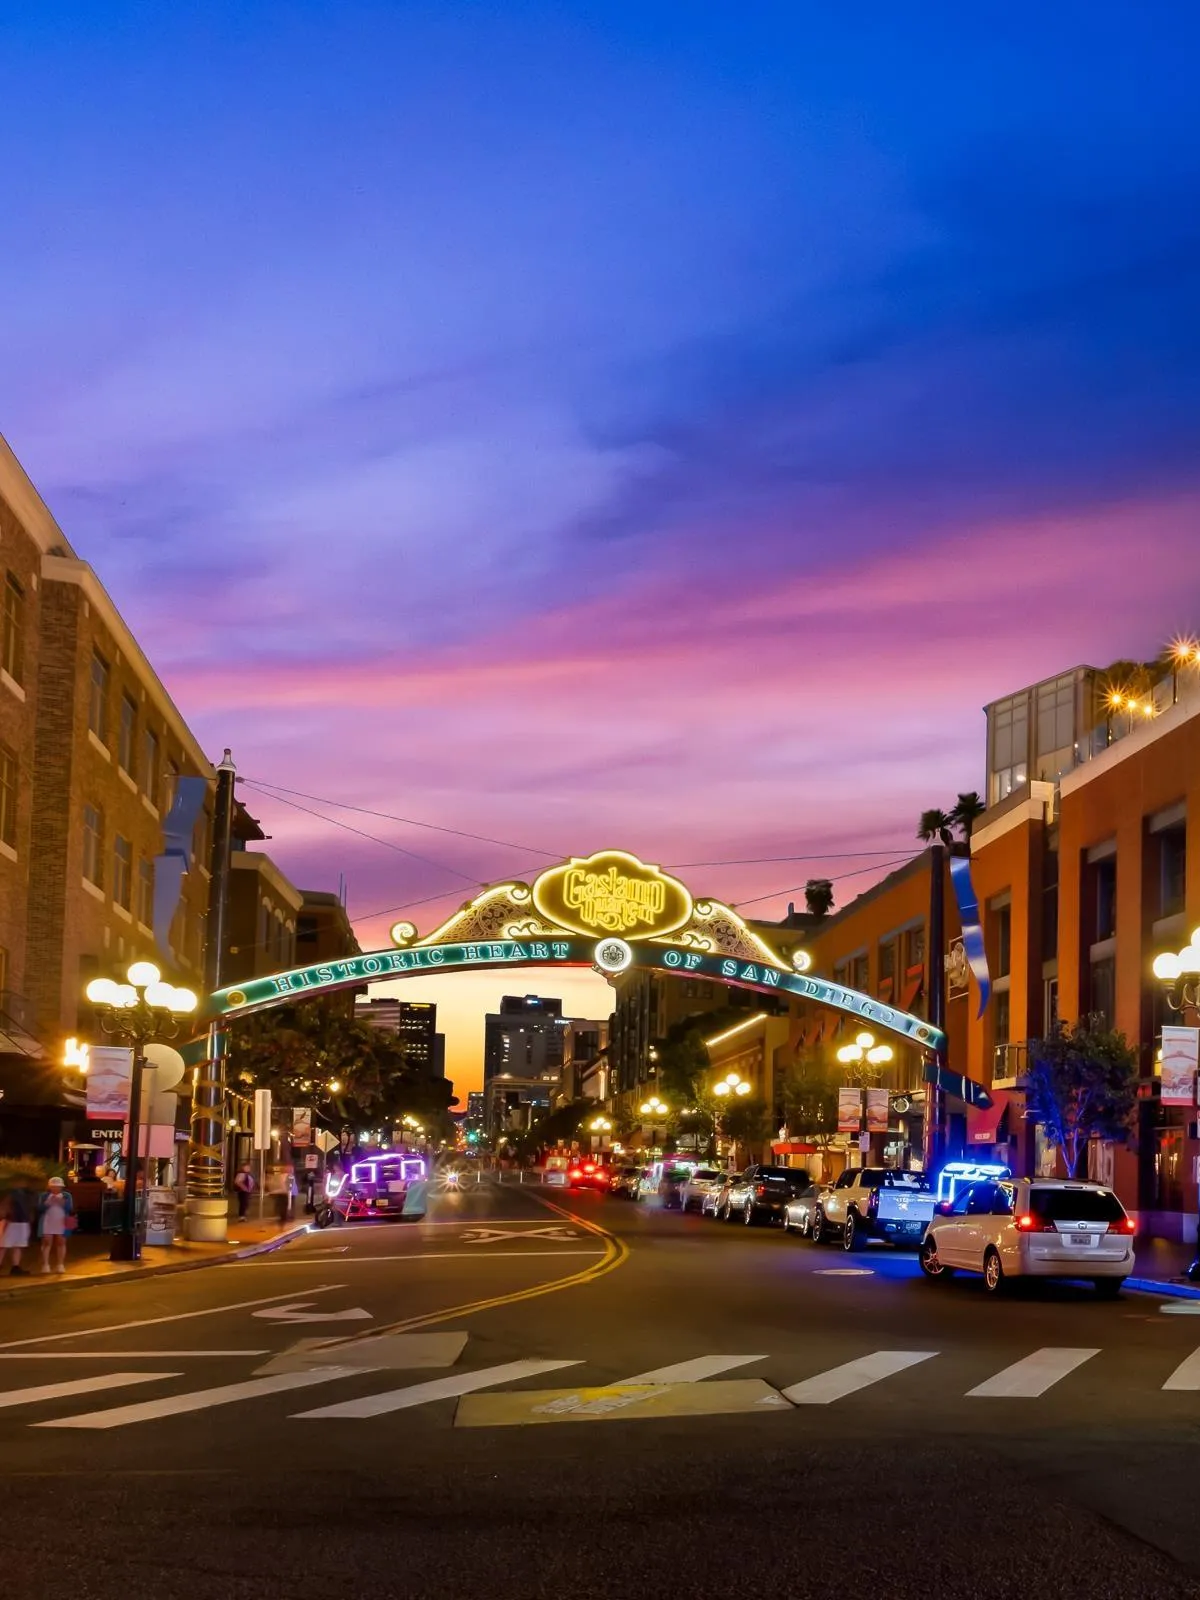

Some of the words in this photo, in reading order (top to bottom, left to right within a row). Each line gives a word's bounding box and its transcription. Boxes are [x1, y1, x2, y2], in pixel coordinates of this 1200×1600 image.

[272, 948, 444, 993] HISTORIC
[463, 942, 569, 962] HEART
[664, 950, 702, 969] OF
[722, 960, 781, 986] SAN
[803, 980, 897, 1023] DIEGO
